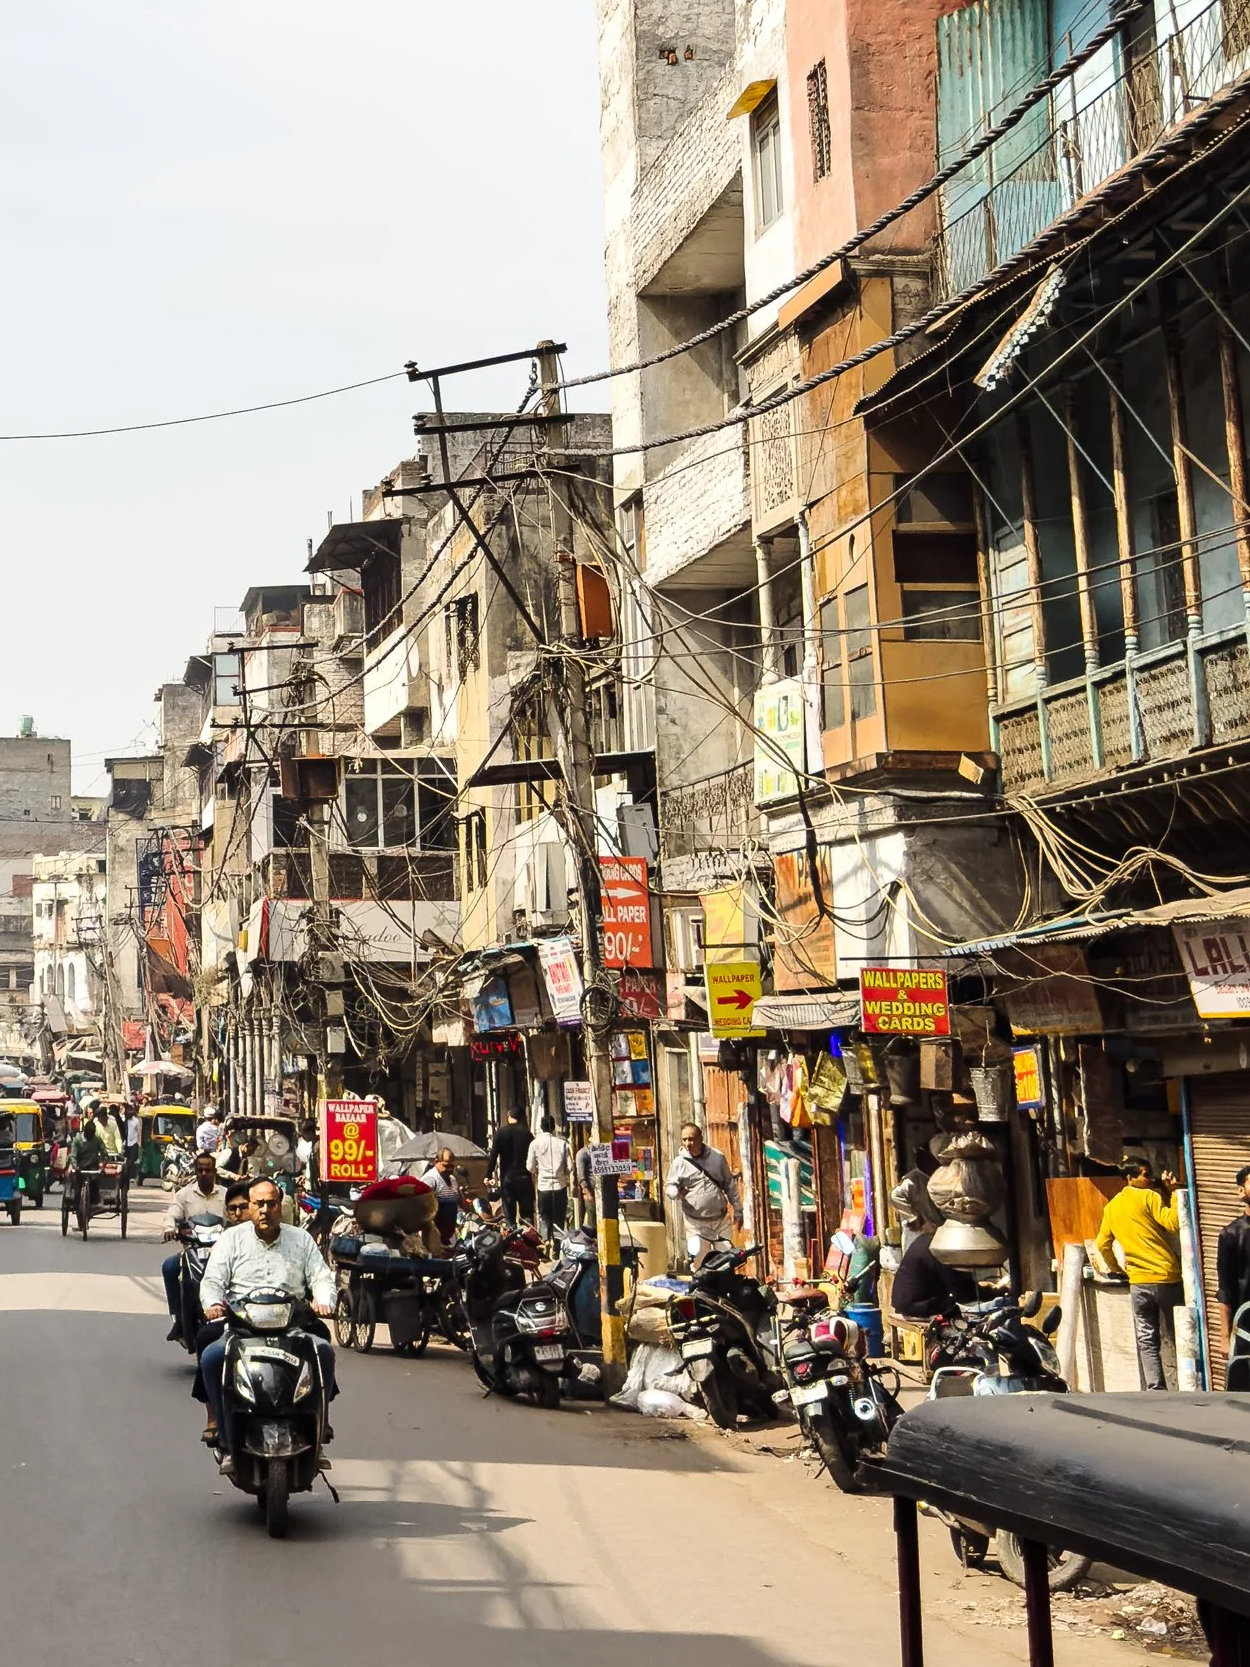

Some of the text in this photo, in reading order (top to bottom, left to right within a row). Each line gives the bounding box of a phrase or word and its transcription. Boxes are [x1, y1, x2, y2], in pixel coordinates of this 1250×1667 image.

[617, 906, 646, 924] PAPER
[712, 973, 755, 984] WALLPAPER
[863, 970, 944, 990] WALLPAPERS
[897, 989, 908, 1000] &
[865, 1001, 946, 1017] WEDDING
[878, 1016, 936, 1031] CARDS
[327, 1103, 374, 1114] WALLPAPER
[335, 1113, 367, 1123] BAZAAR
[343, 1122, 360, 1139] @
[330, 1139, 374, 1162] 99/-
